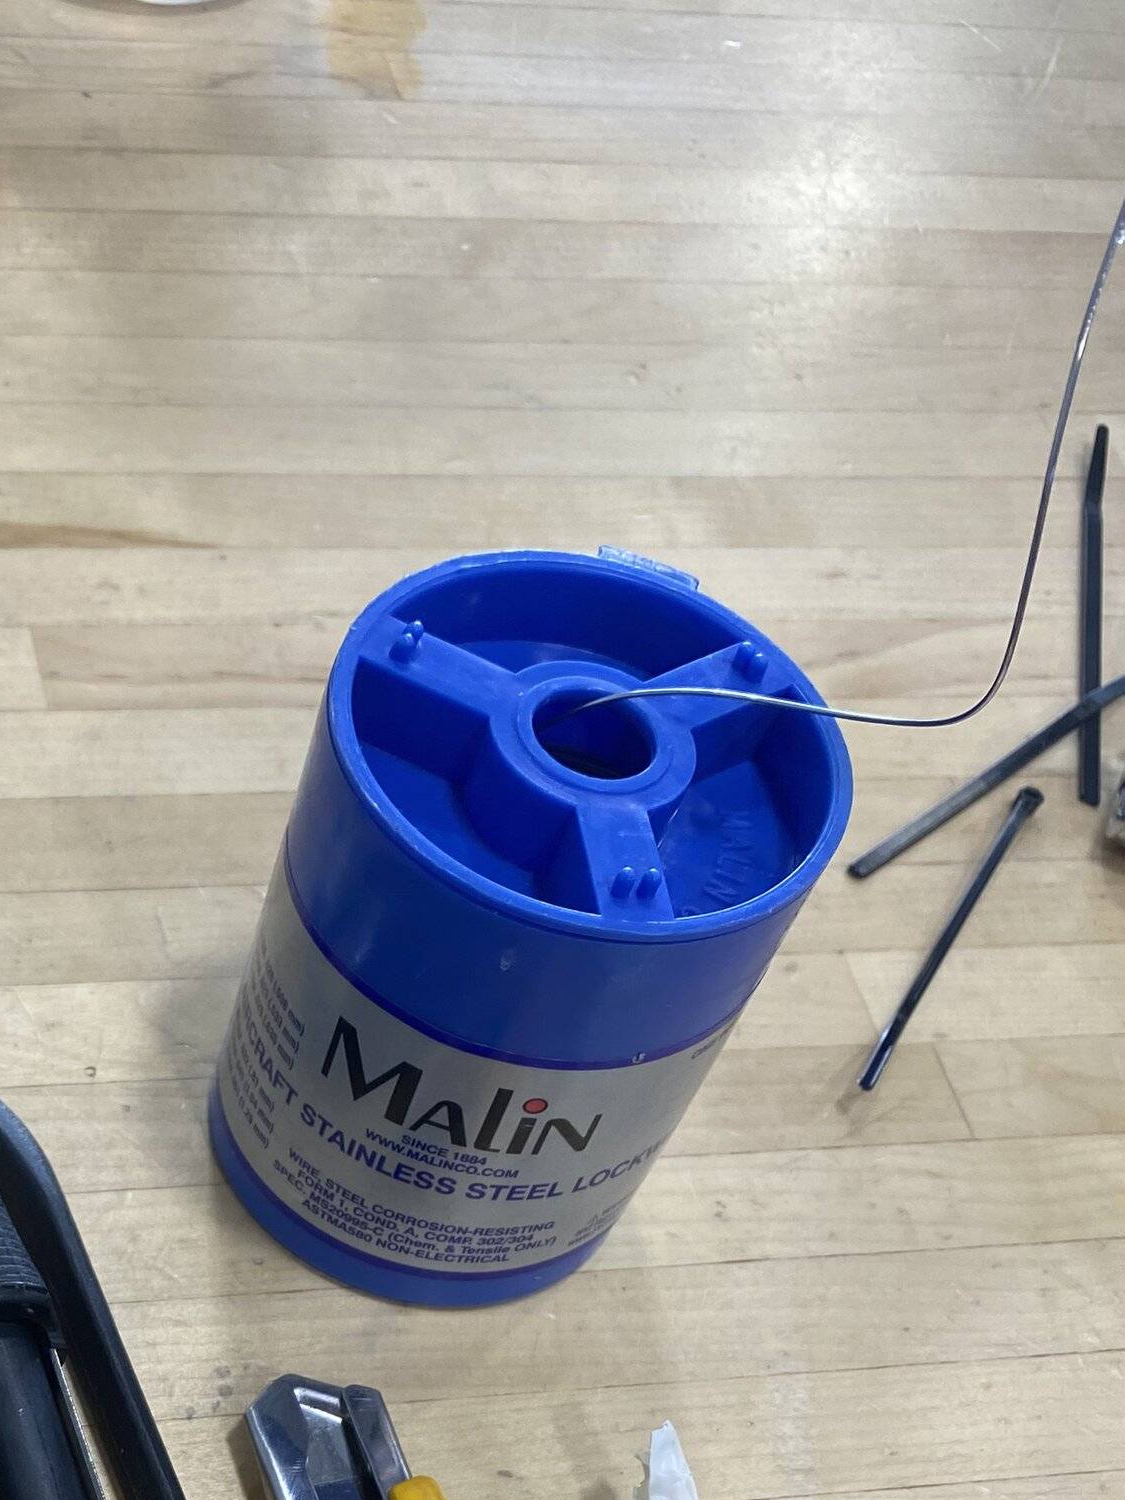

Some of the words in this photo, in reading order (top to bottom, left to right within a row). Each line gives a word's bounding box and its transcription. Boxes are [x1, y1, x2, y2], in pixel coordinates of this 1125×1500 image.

[300, 1102, 458, 1196] STAINLESS
[465, 1181, 565, 1201] STEEL
[365, 1128, 520, 1179] WWW.MALINCO.COM
[401, 1134, 449, 1159] SINCE
[453, 1151, 487, 1166] 1884
[297, 1168, 334, 1201] FORM
[353, 1204, 400, 1232] COND.
[477, 1234, 533, 1246] 302/304
[326, 1178, 367, 1208] STEEL
[372, 1203, 555, 1237] CORROSION-RESISTING
[376, 1238, 509, 1263] NON-ELECTRICAL
[388, 1231, 440, 1252] (Chem.
[445, 1244, 455, 1254] &
[461, 1245, 510, 1255] Tensile
[514, 1236, 556, 1251] ONLY)
